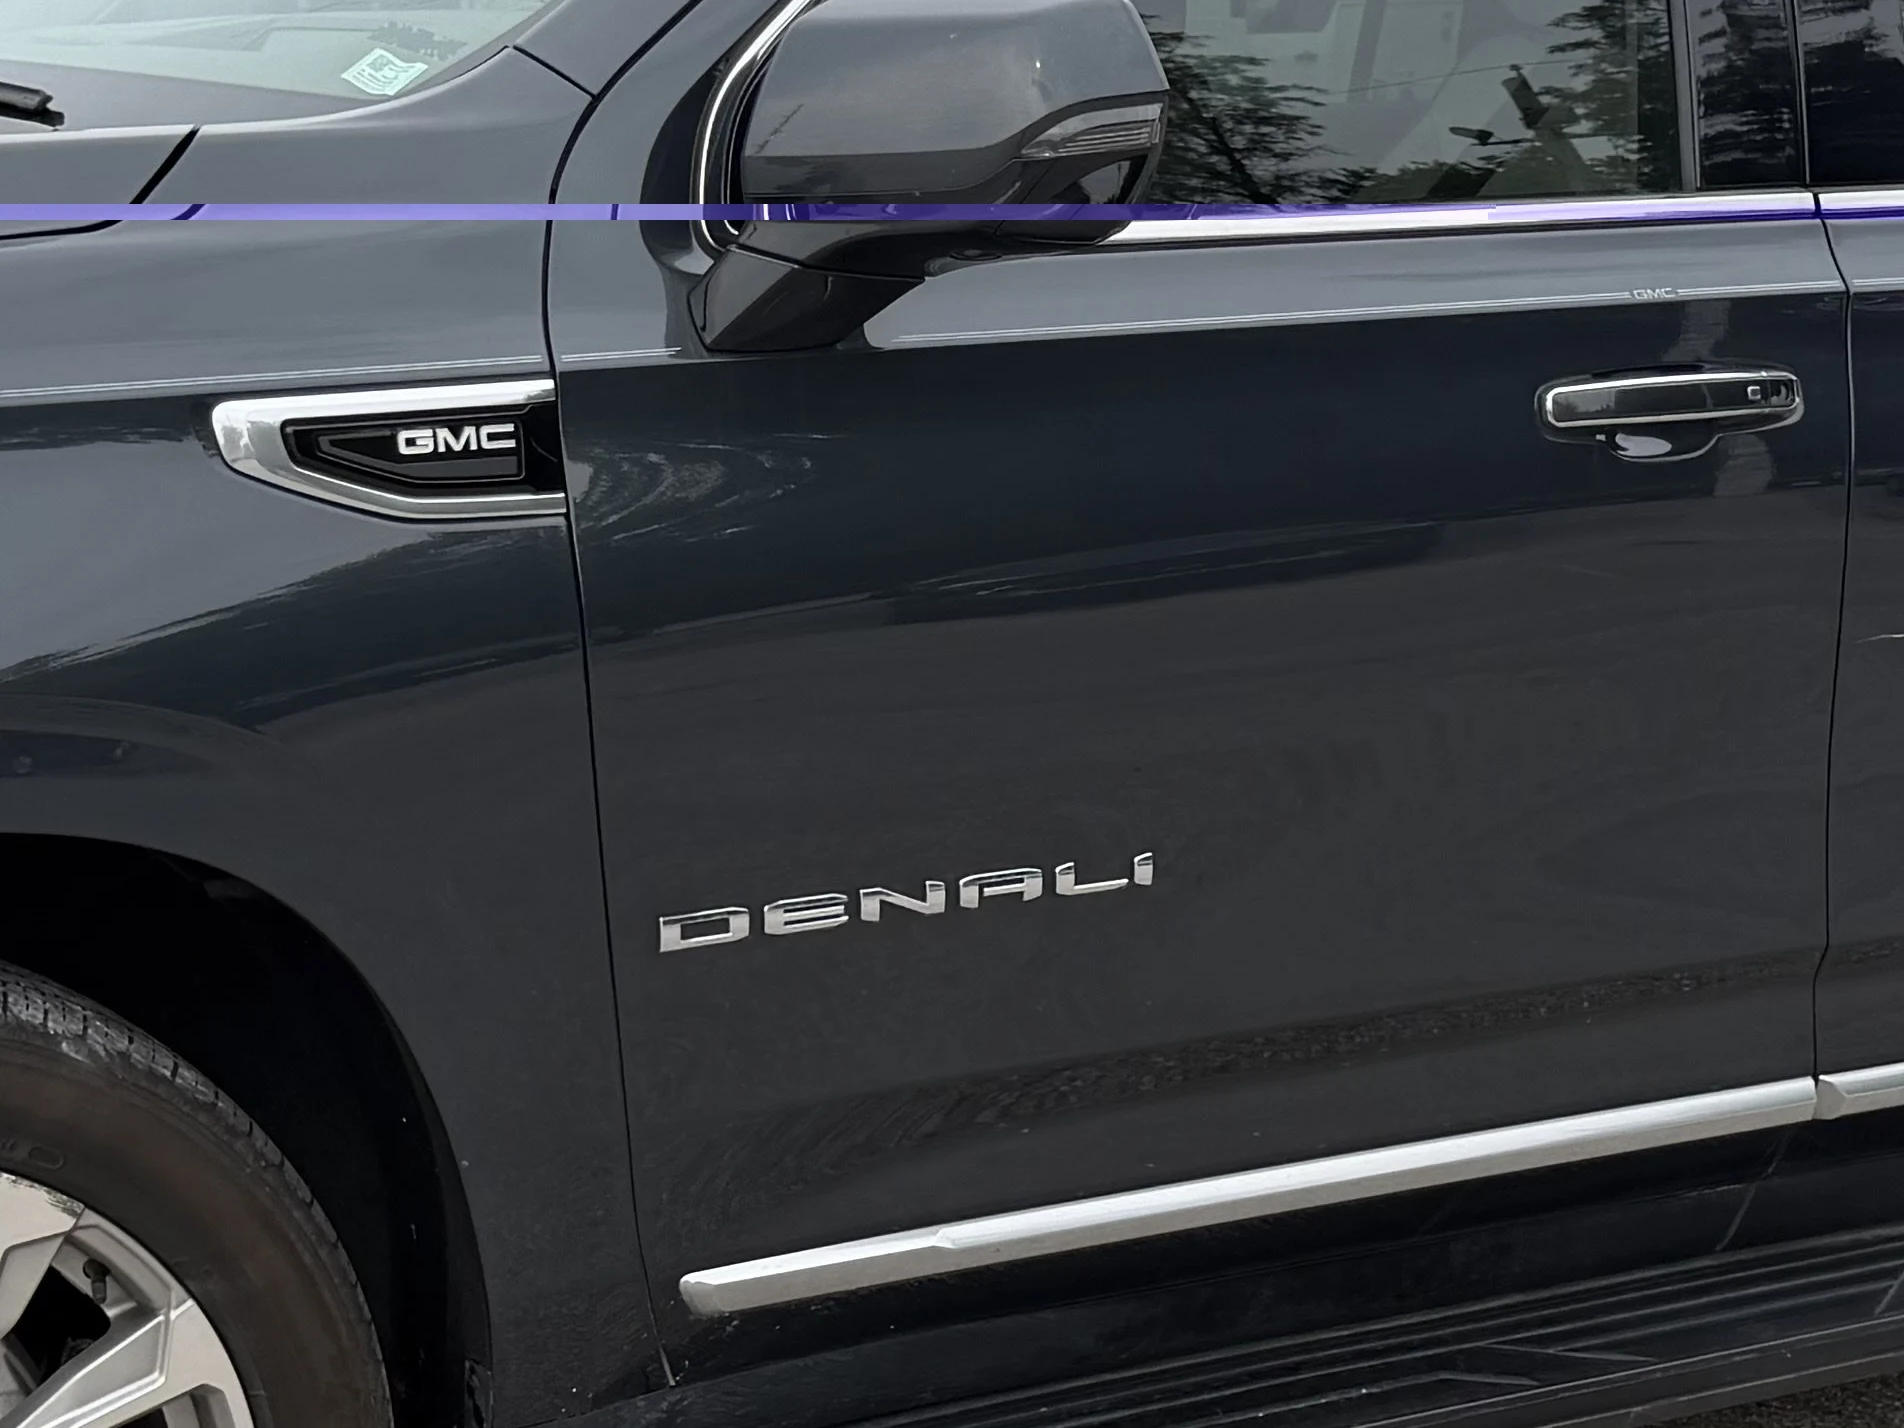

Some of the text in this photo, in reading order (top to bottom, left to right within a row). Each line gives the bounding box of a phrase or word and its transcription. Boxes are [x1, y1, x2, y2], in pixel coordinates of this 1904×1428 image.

[1632, 287, 1676, 300] GMC
[397, 423, 516, 455] GMC
[659, 852, 1153, 952] DENALI
